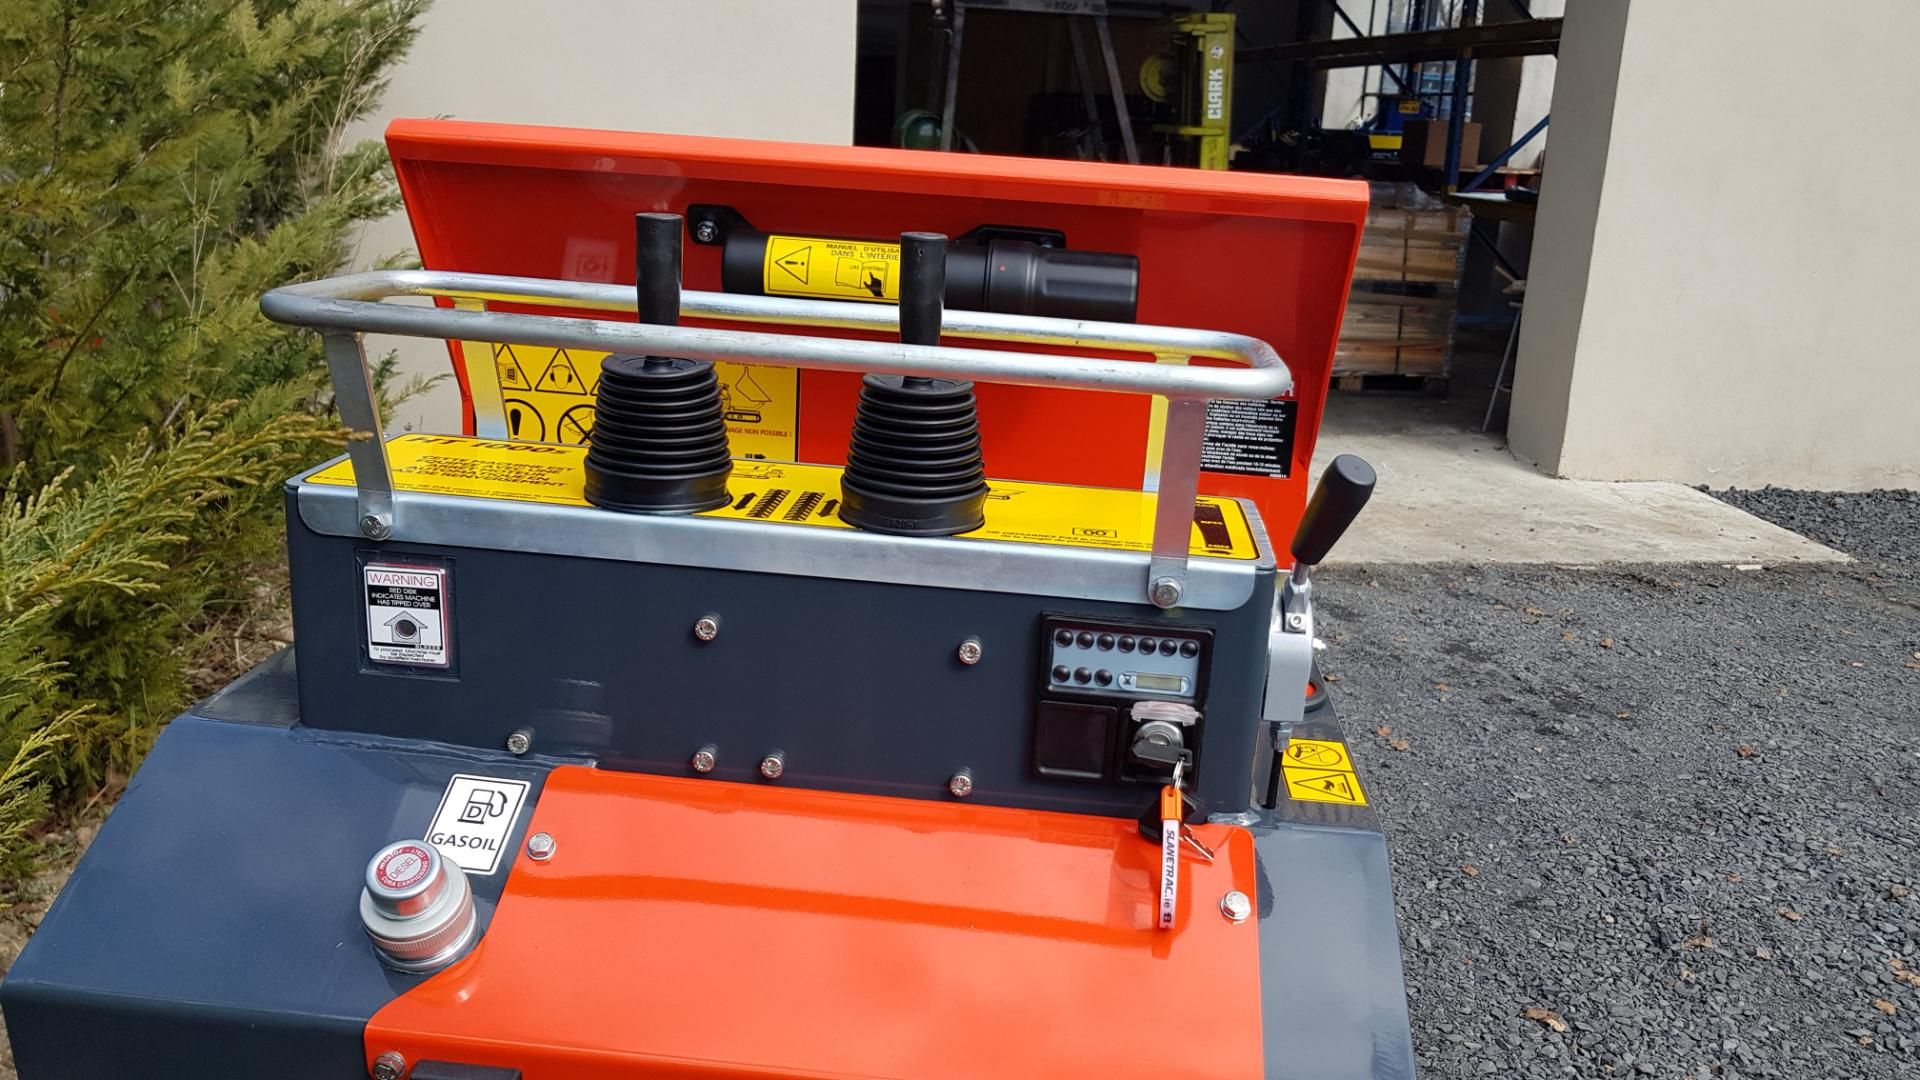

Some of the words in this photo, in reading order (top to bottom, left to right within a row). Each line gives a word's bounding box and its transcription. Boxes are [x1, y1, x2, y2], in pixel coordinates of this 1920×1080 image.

[1207, 68, 1223, 119] CLARK
[826, 244, 858, 252] MANUEL
[369, 573, 434, 587] WARNING
[466, 805, 482, 818] D
[430, 832, 496, 851] GASOIL
[389, 857, 418, 880] DIESEL
[1164, 829, 1175, 908] SLANETRAC.ie
